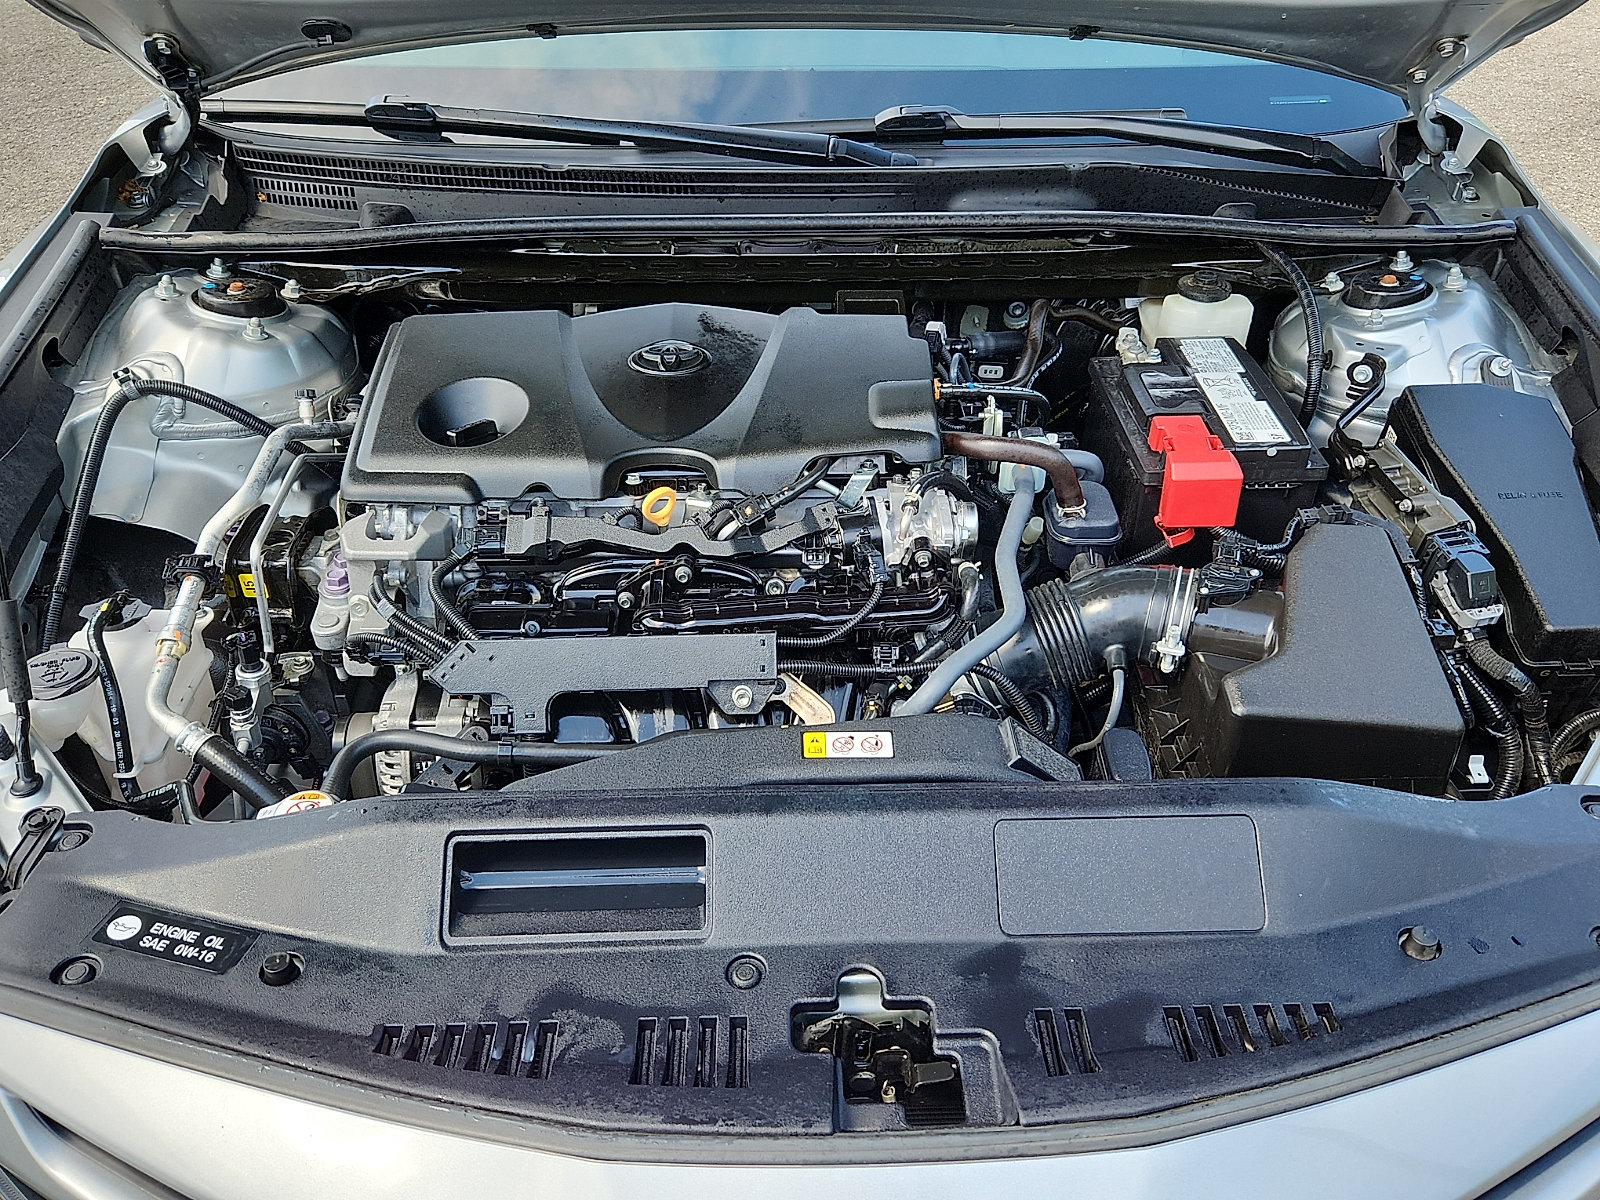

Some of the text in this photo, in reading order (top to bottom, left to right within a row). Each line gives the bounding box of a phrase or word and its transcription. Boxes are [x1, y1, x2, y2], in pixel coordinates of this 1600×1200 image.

[116, 741, 124, 759] WATER
[139, 935, 217, 963] SAE 0W-16
[149, 922, 225, 950] ENGINE OIL
